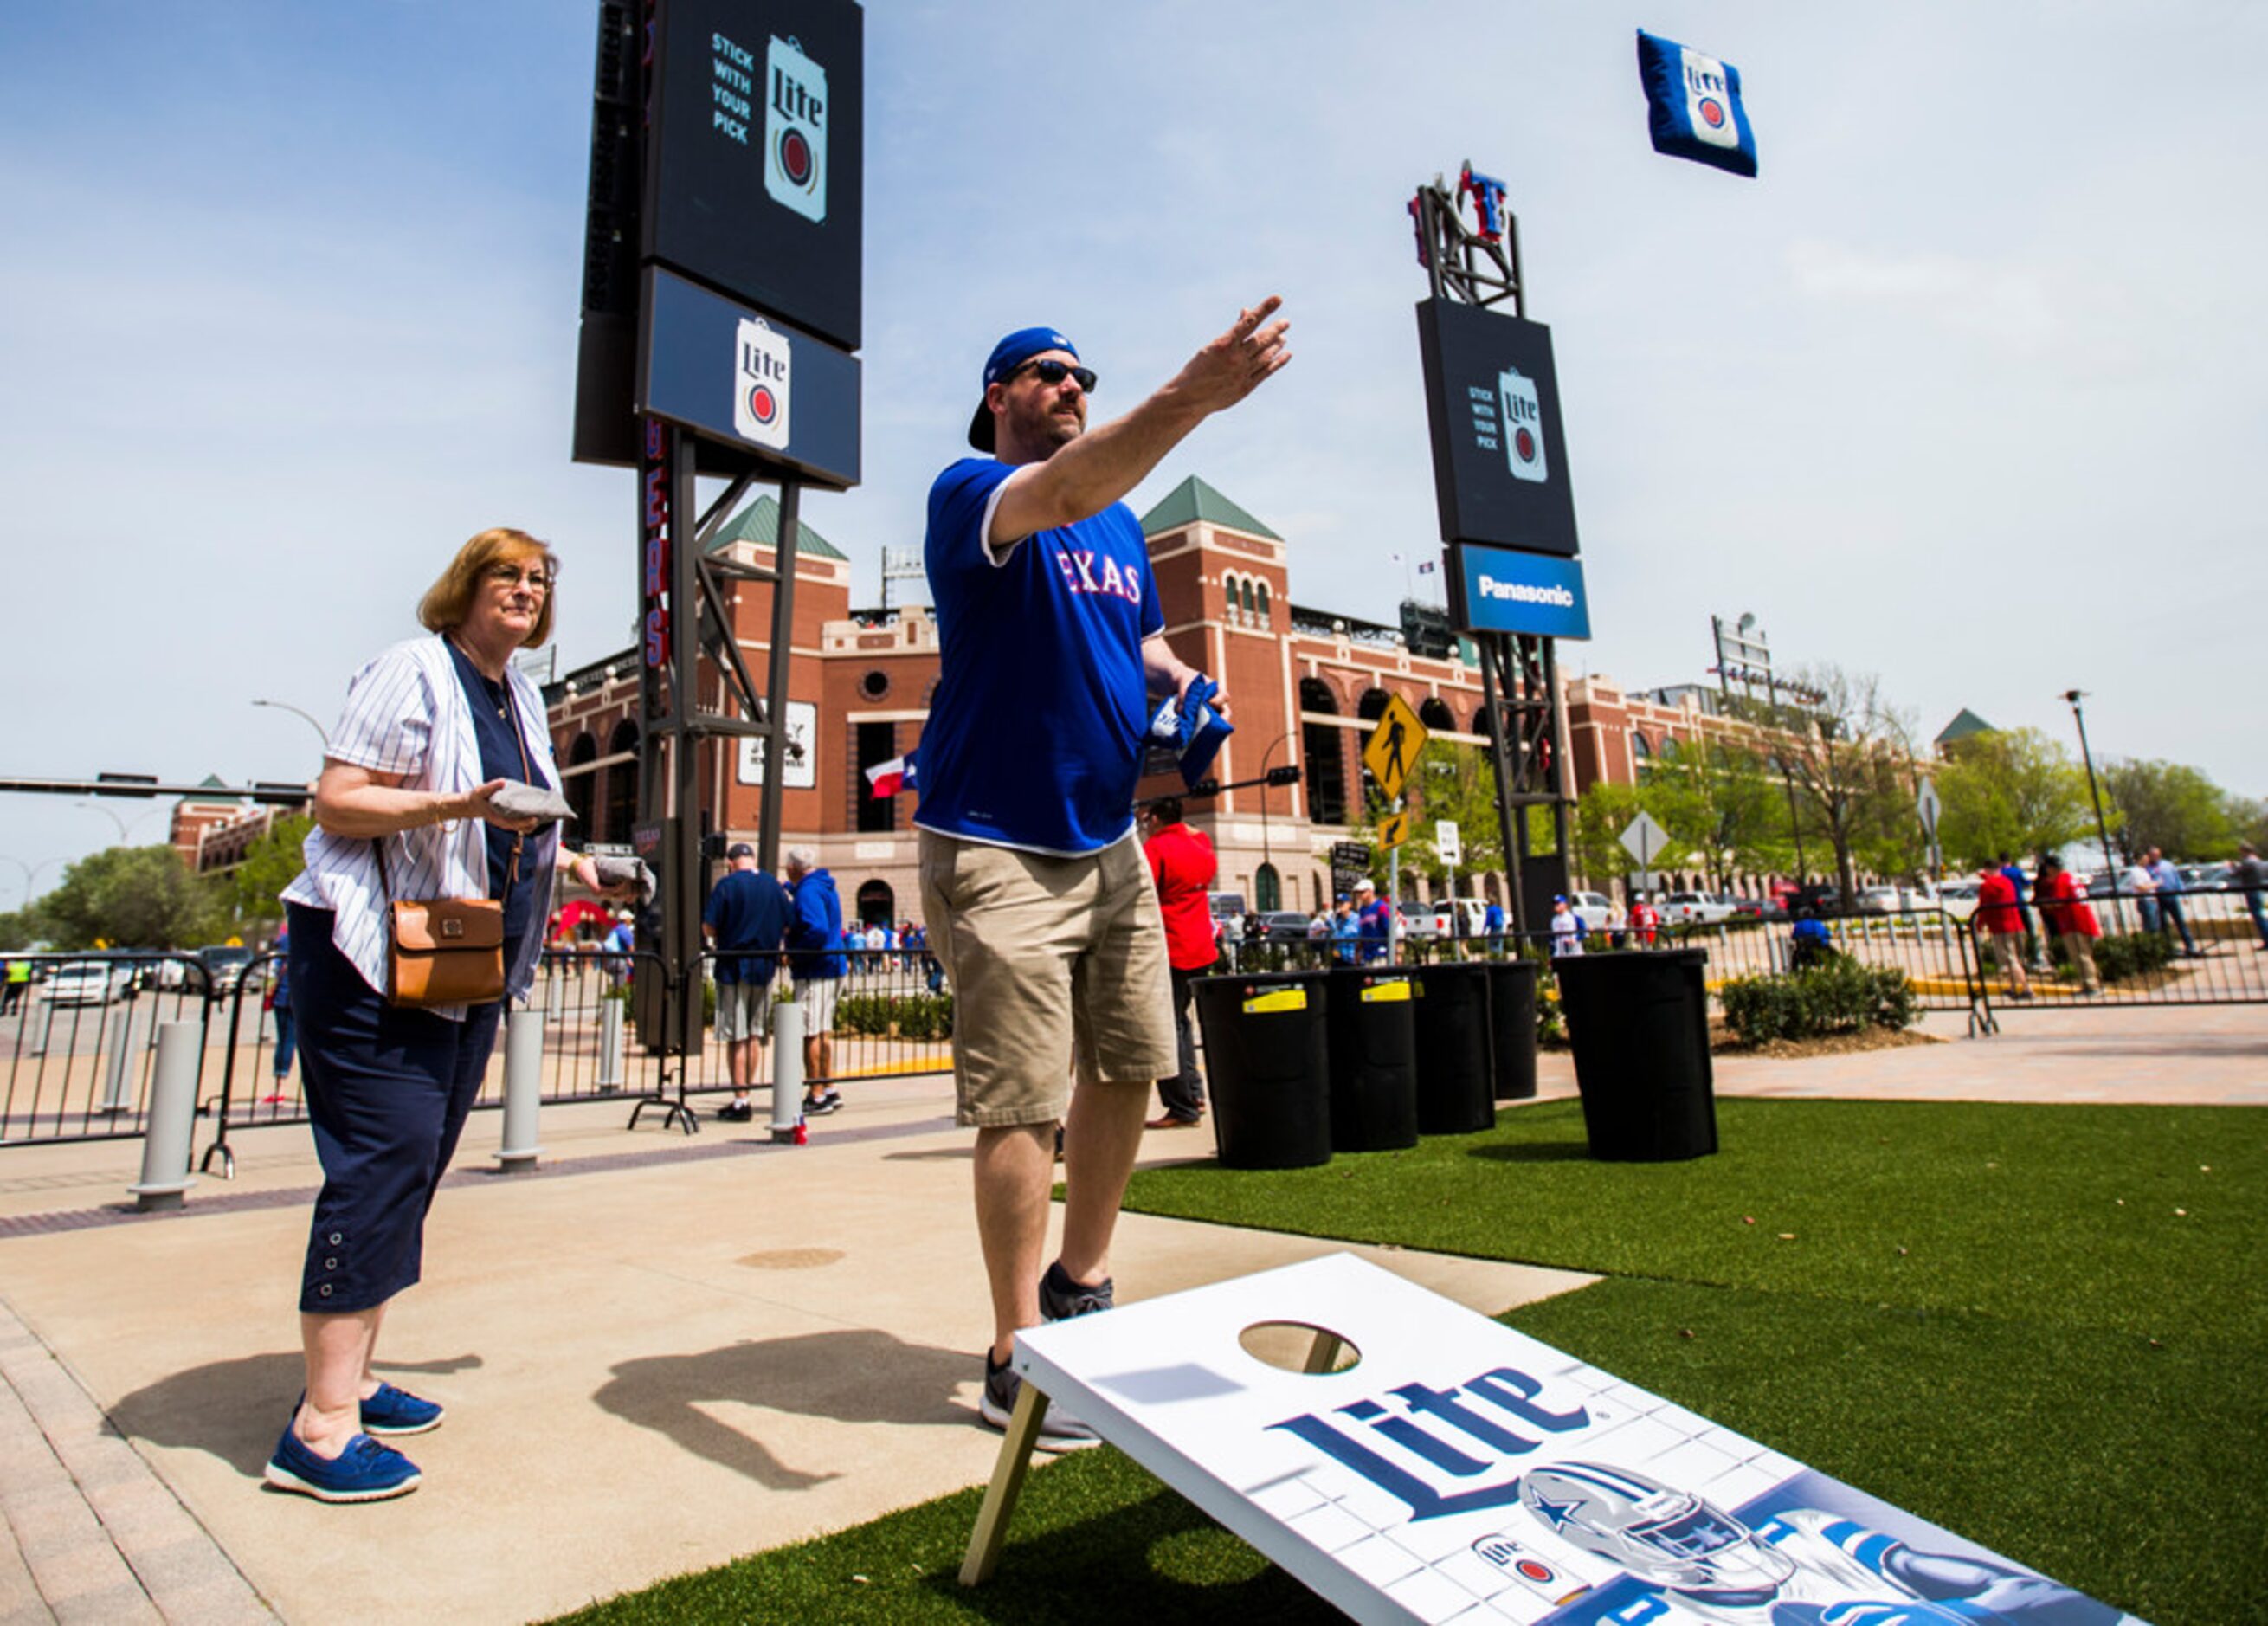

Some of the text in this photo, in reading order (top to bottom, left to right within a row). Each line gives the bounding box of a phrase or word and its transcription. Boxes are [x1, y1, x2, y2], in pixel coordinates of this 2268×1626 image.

[712, 32, 754, 72] STICK
[713, 57, 751, 96] WITH
[772, 65, 823, 127] Lite
[712, 82, 751, 121] YOUR
[713, 109, 748, 145] PICK
[744, 340, 786, 382] Lite
[1505, 391, 1537, 424] Lite
[1479, 574, 1575, 608] Panasonic
[1262, 1366, 1591, 1523] Lite
